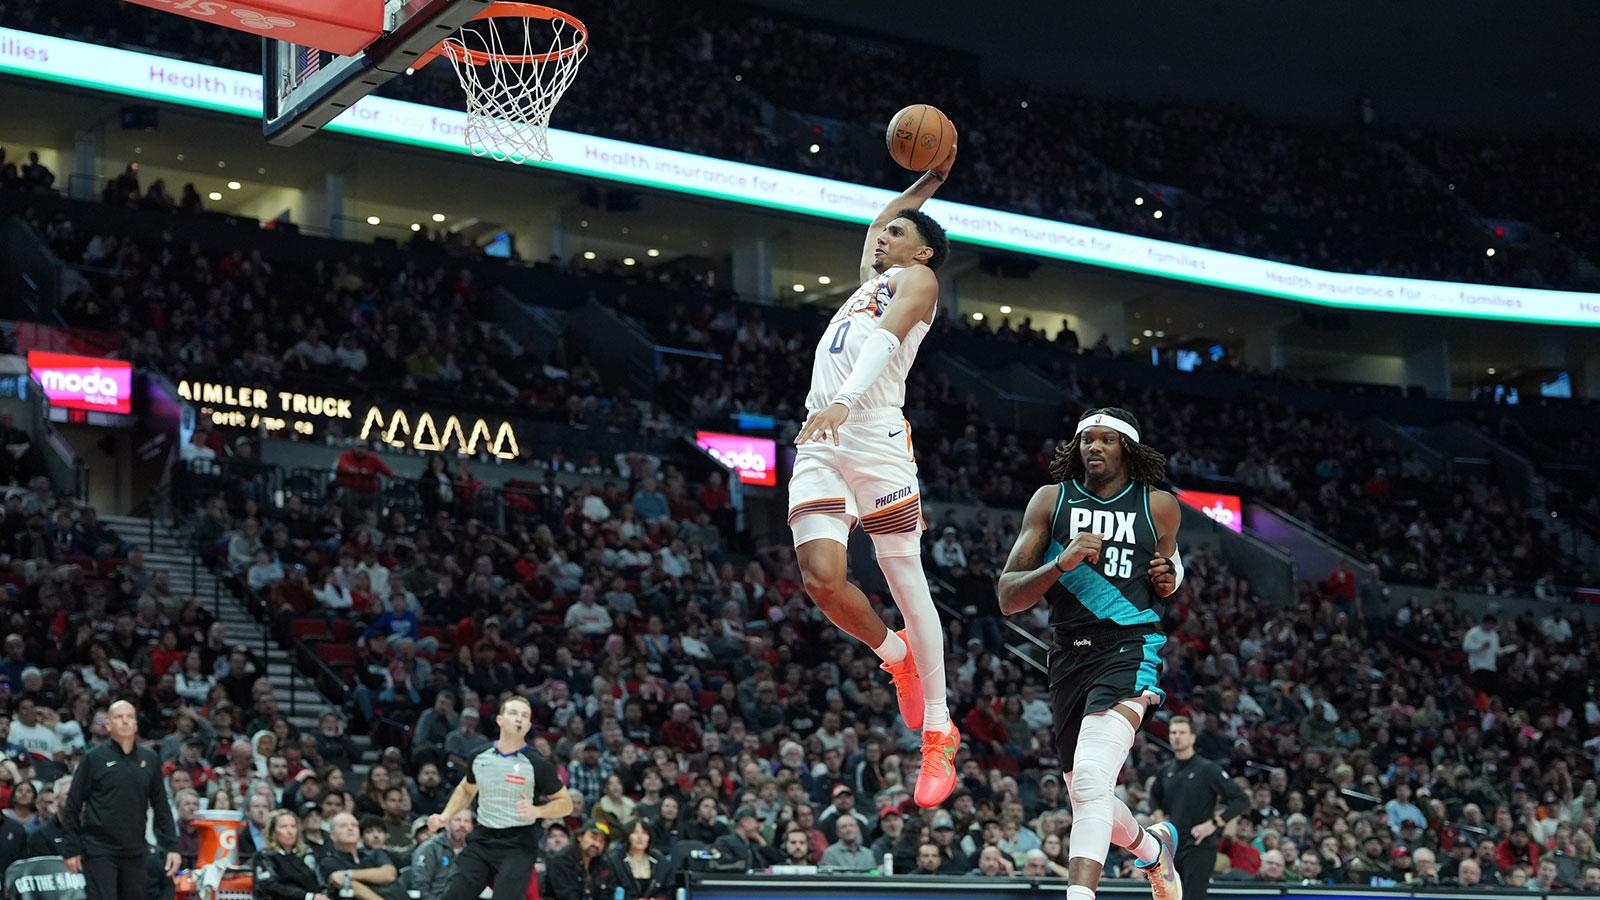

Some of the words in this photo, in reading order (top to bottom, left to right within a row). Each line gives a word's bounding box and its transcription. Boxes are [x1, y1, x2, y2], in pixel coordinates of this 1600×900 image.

[156, 0, 228, 16] St
[149, 66, 227, 95] Health
[351, 104, 381, 121] for
[584, 145, 650, 170] Health
[655, 161, 748, 188] insurance
[753, 175, 778, 192] for
[948, 212, 1004, 234] Health
[1008, 225, 1086, 249] insurance
[1090, 236, 1112, 251] for
[1147, 248, 1207, 271] families
[1265, 270, 1313, 289] Health
[1316, 282, 1395, 298] insurance
[1399, 286, 1422, 300] for
[1459, 291, 1523, 309] families
[828, 320, 851, 354] 0
[41, 366, 118, 397] moda
[278, 391, 352, 419] TRUCK
[875, 485, 913, 508] PHOENIX
[1069, 507, 1137, 545] PDX
[1103, 546, 1135, 579] 35
[219, 829, 237, 851] G
[15, 874, 36, 894] GET
[34, 874, 57, 892] THE
